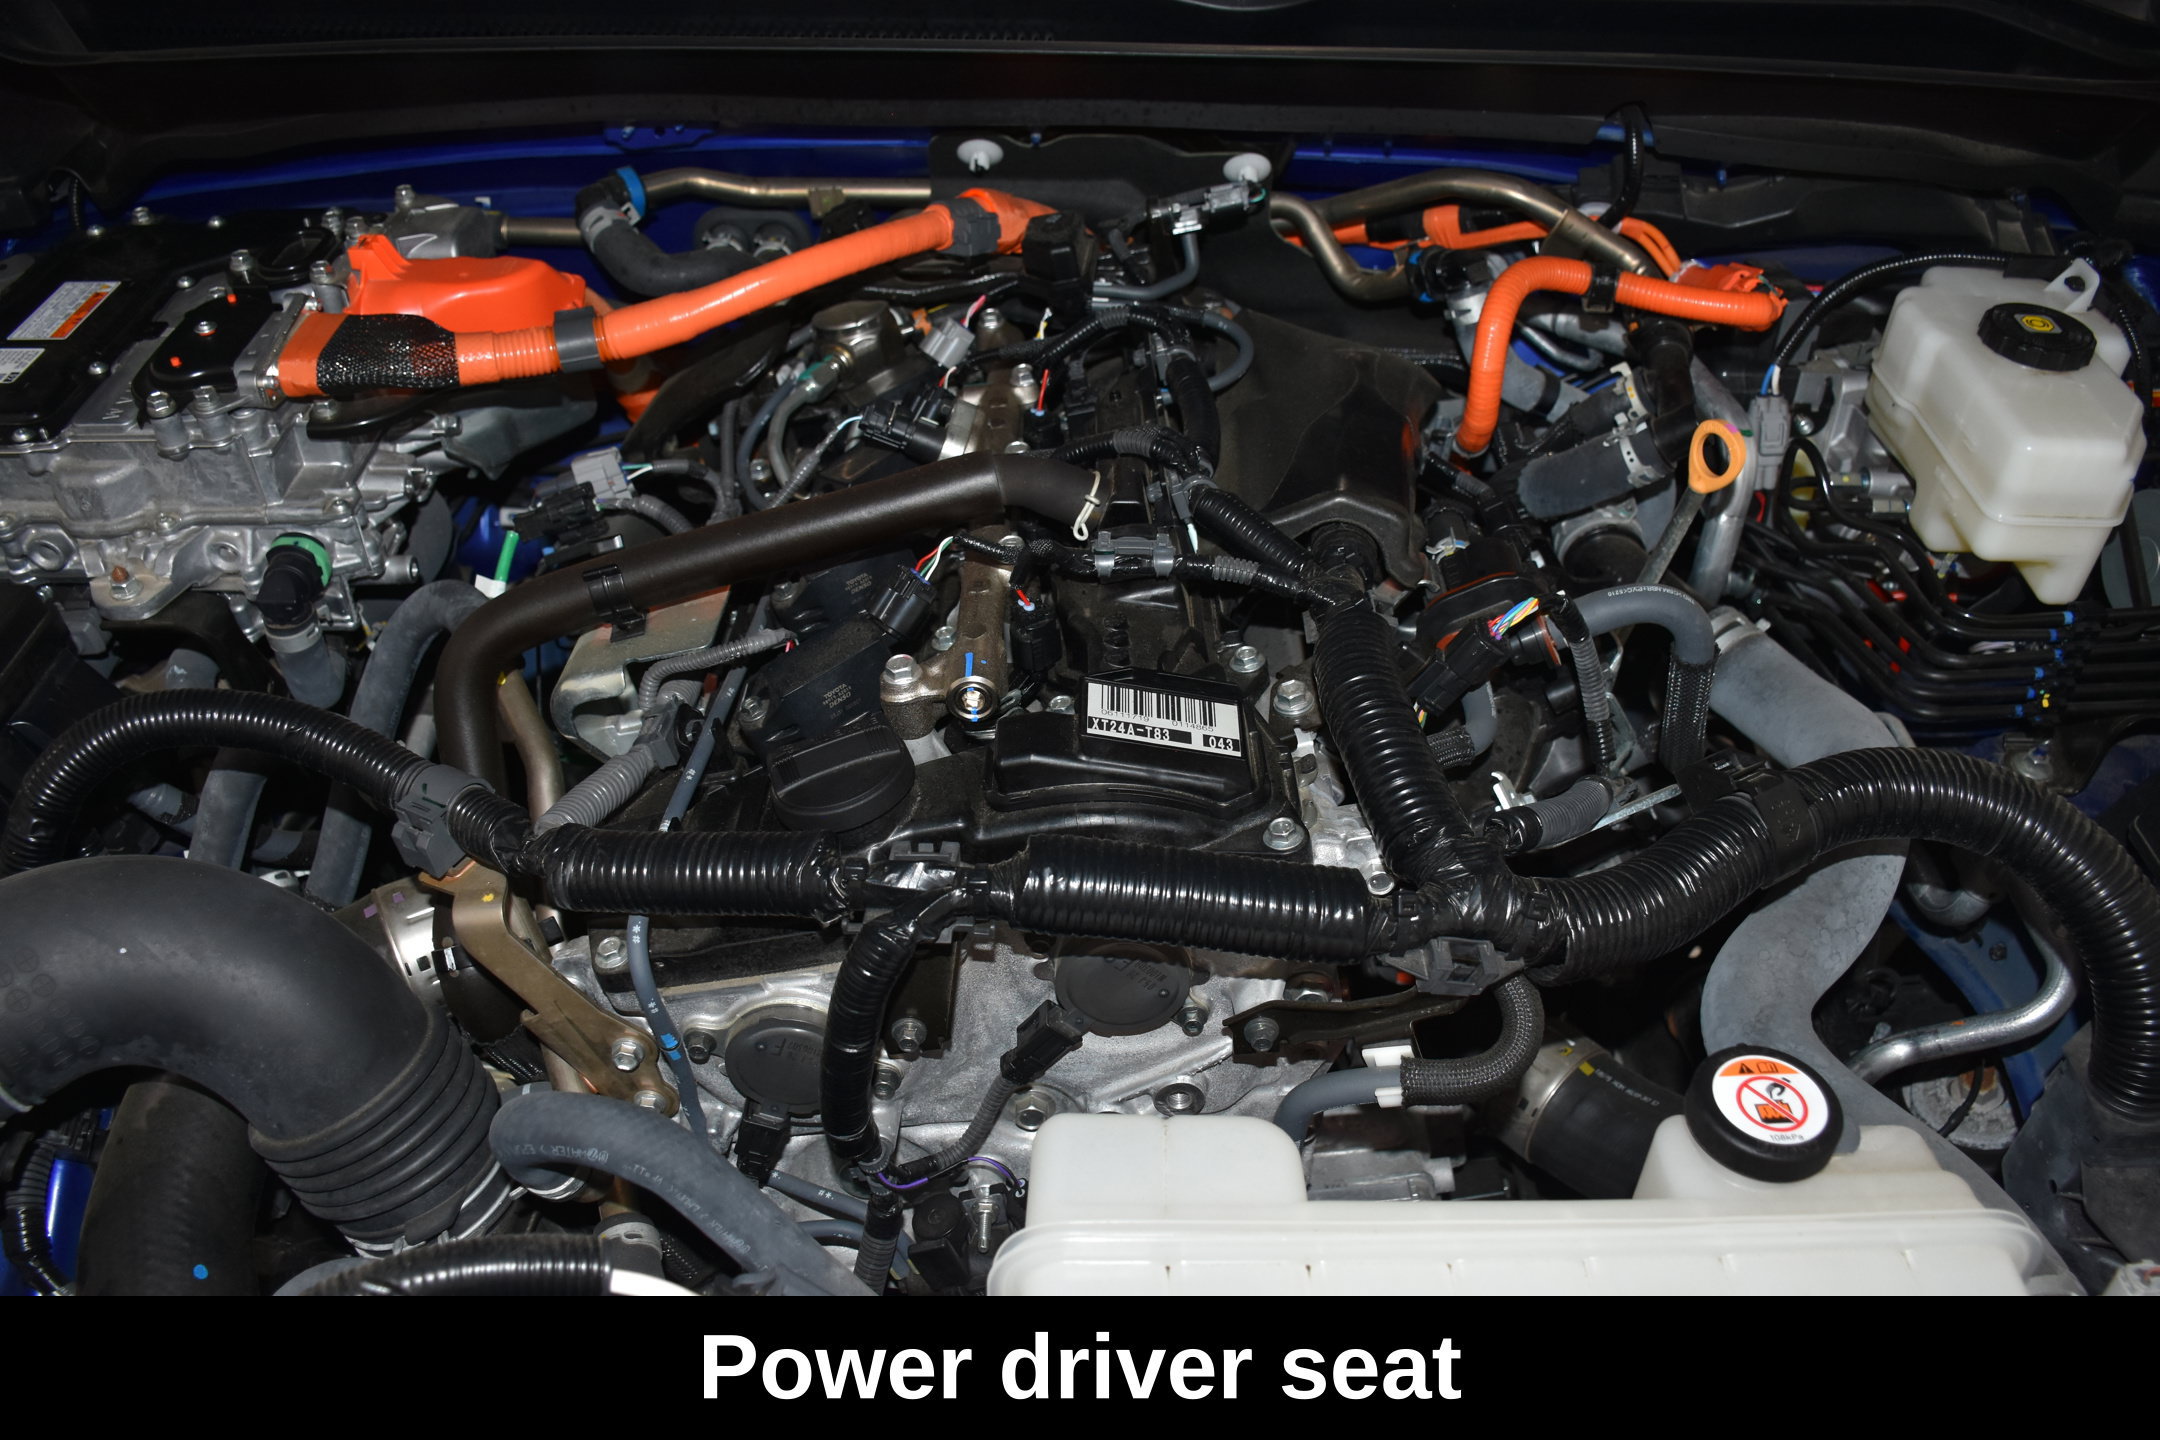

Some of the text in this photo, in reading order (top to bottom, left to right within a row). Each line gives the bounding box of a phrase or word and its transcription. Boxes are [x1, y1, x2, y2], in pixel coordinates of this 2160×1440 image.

[823, 683, 848, 699] TOYOTA
[828, 691, 852, 709] DENSO
[1101, 709, 1150, 723] 06111719
[1172, 720, 1214, 733] 0114865
[1092, 718, 1234, 752] XT24A-T83 043
